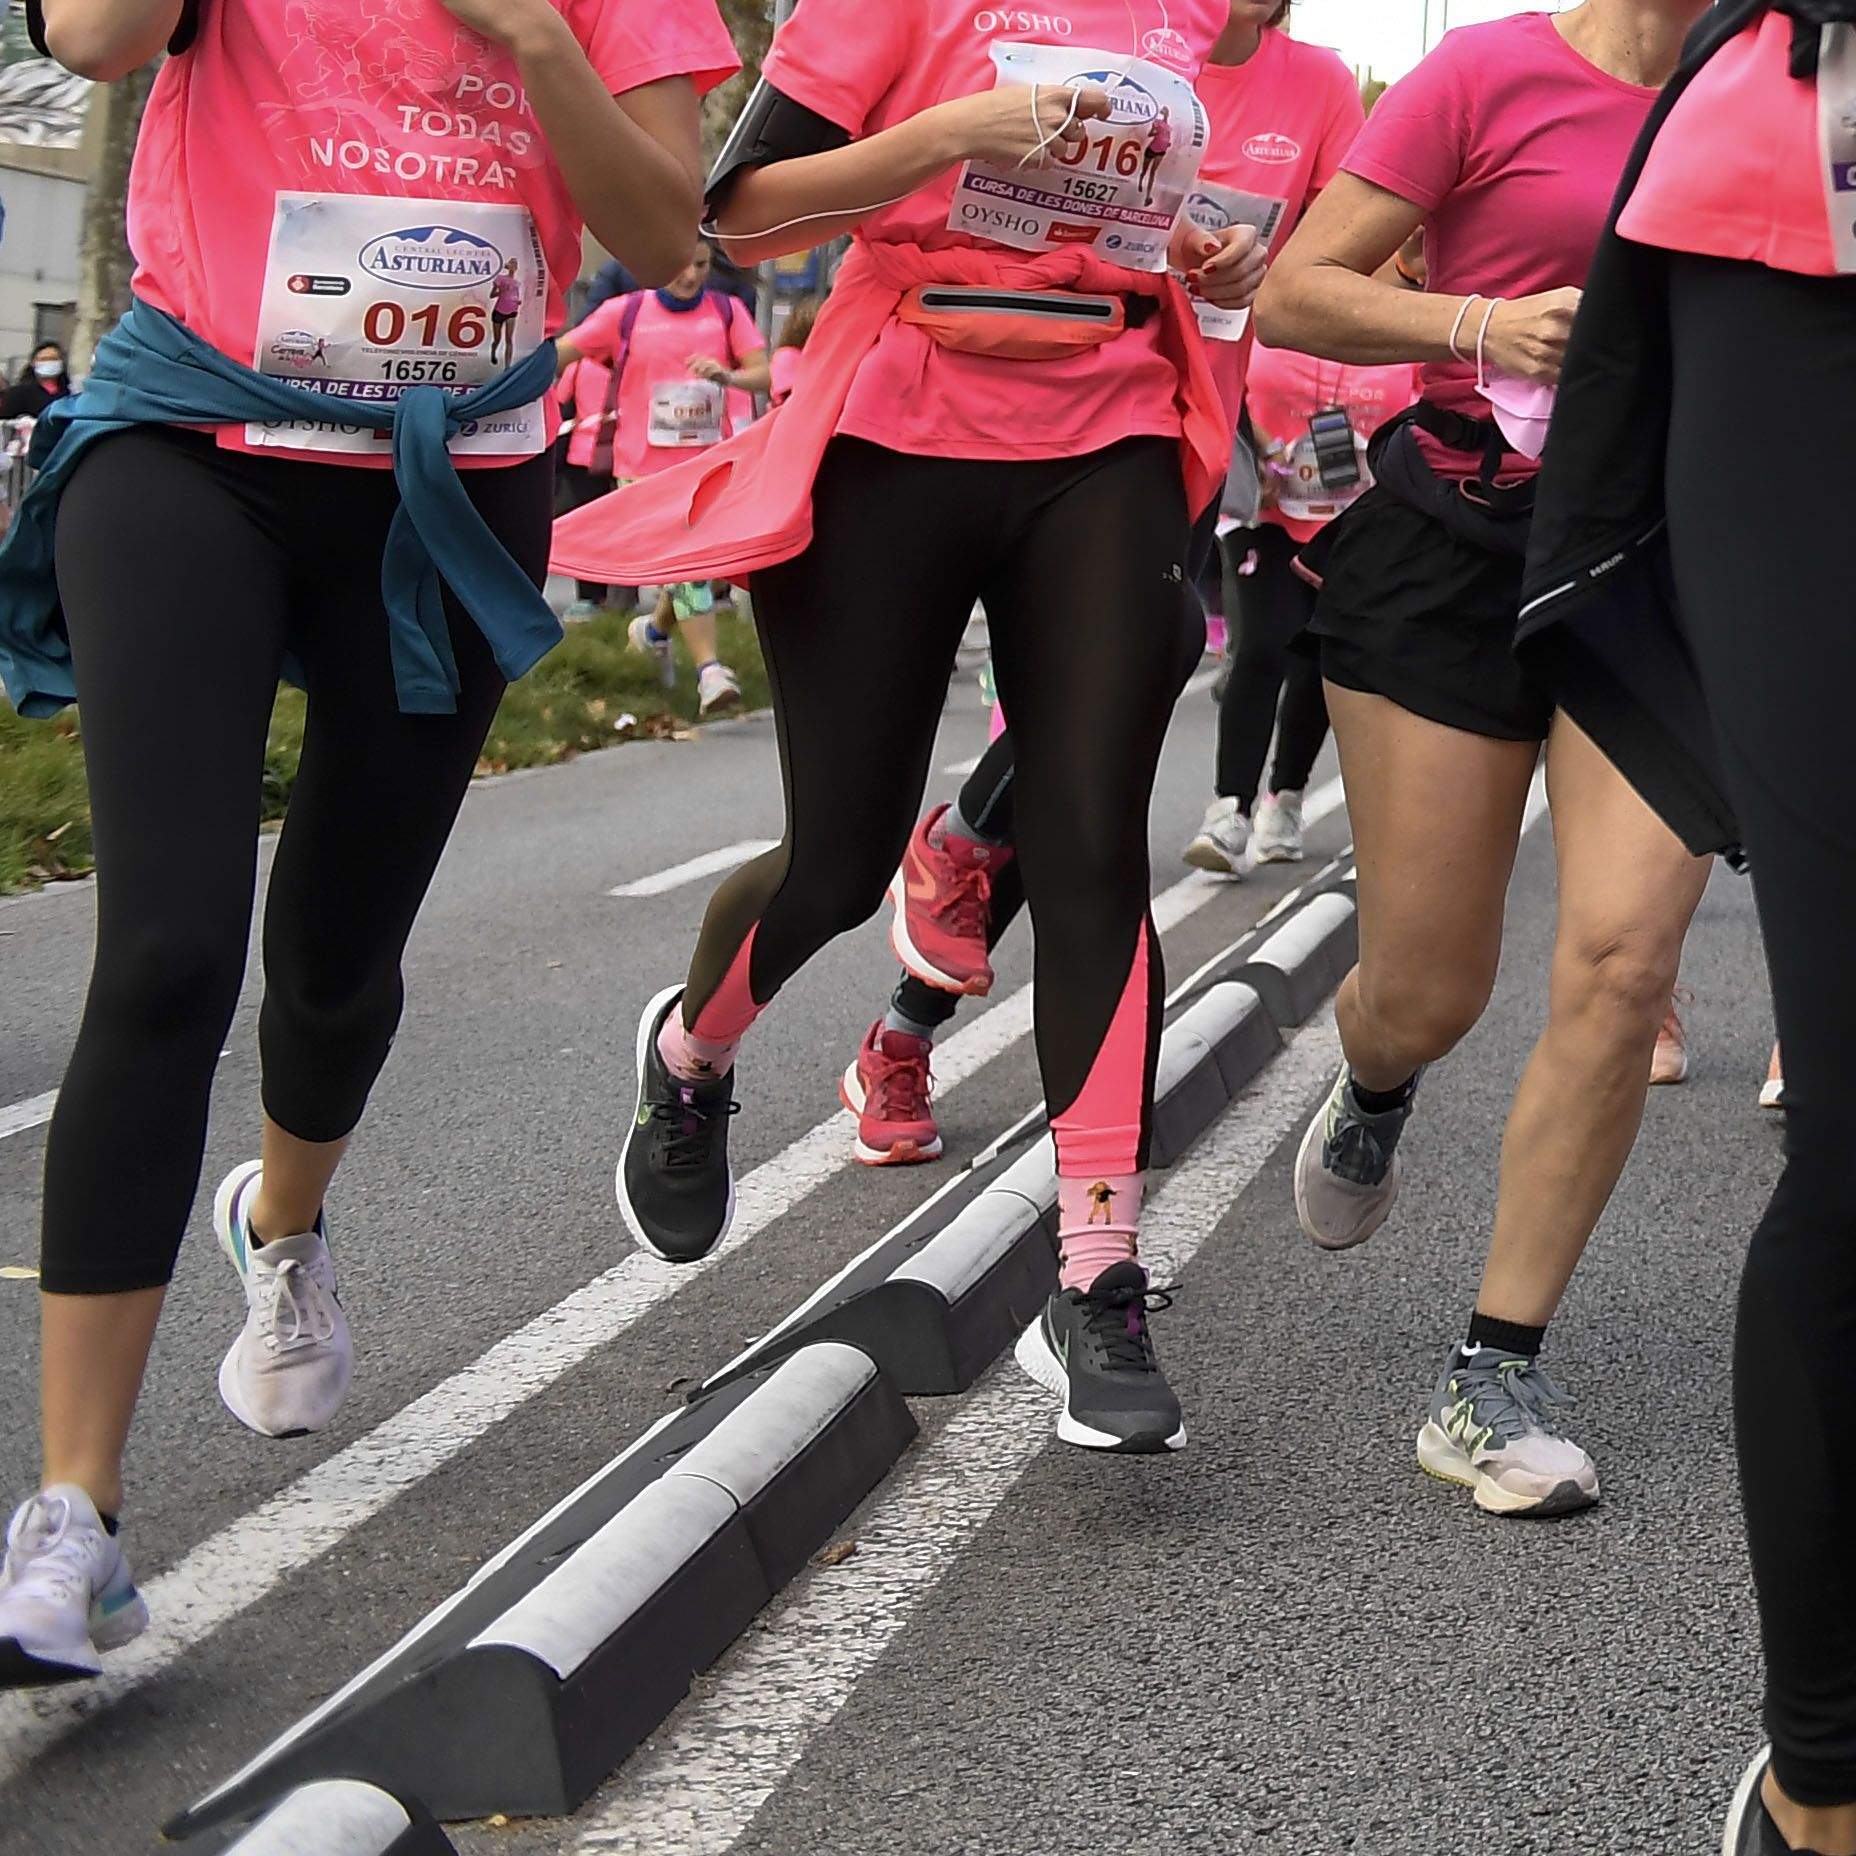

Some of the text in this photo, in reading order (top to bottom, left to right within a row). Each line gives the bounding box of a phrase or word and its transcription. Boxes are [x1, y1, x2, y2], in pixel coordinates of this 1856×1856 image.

[973, 10, 1073, 36] OYSHO
[1110, 96, 1151, 117] RIANA
[397, 105, 532, 156] TODAS
[971, 177, 1171, 227] CURSA DE LES DONES DE BARCELONA
[1063, 177, 1118, 203] 15627
[961, 203, 1039, 235] OYSHO
[370, 245, 492, 276] ASTURIANA
[363, 301, 487, 349] 016
[381, 359, 456, 383] 16576
[326, 384, 347, 397] DE
[352, 385, 383, 399] LES
